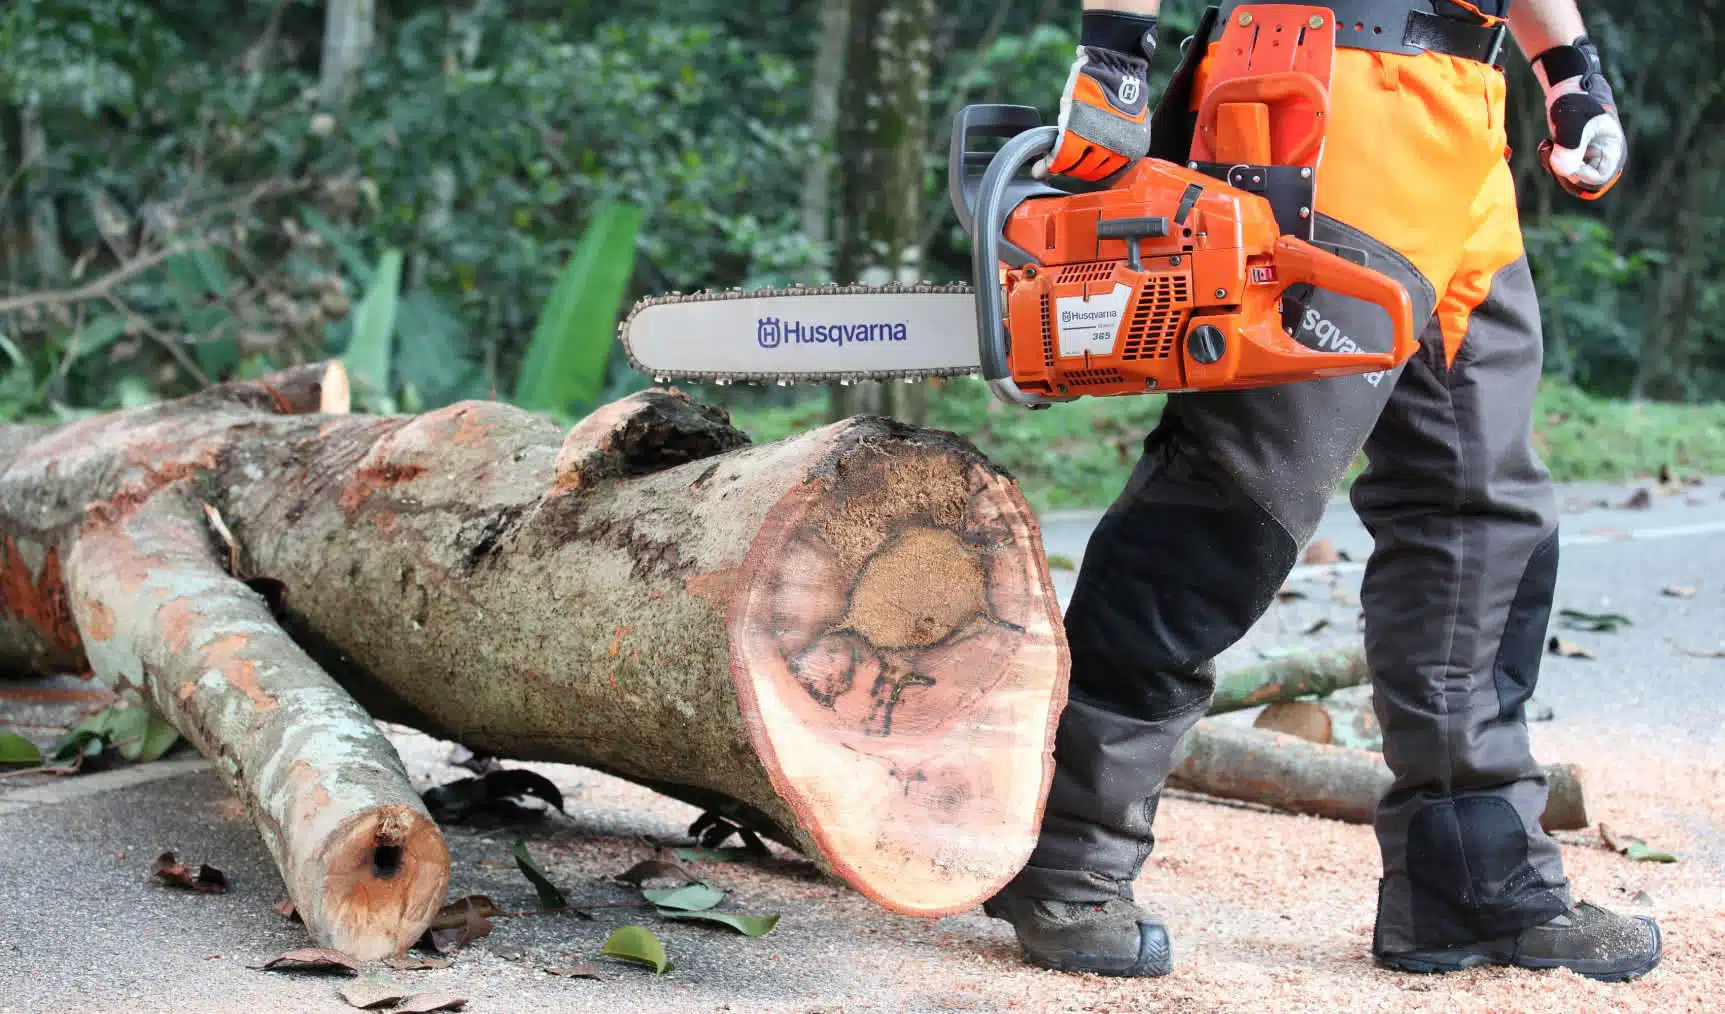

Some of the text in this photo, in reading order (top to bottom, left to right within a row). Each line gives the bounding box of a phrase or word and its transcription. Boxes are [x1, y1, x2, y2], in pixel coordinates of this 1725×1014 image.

[1071, 310, 1117, 321] Husqvarna
[784, 320, 907, 347] Husqvarna
[1092, 331, 1111, 341] 365
